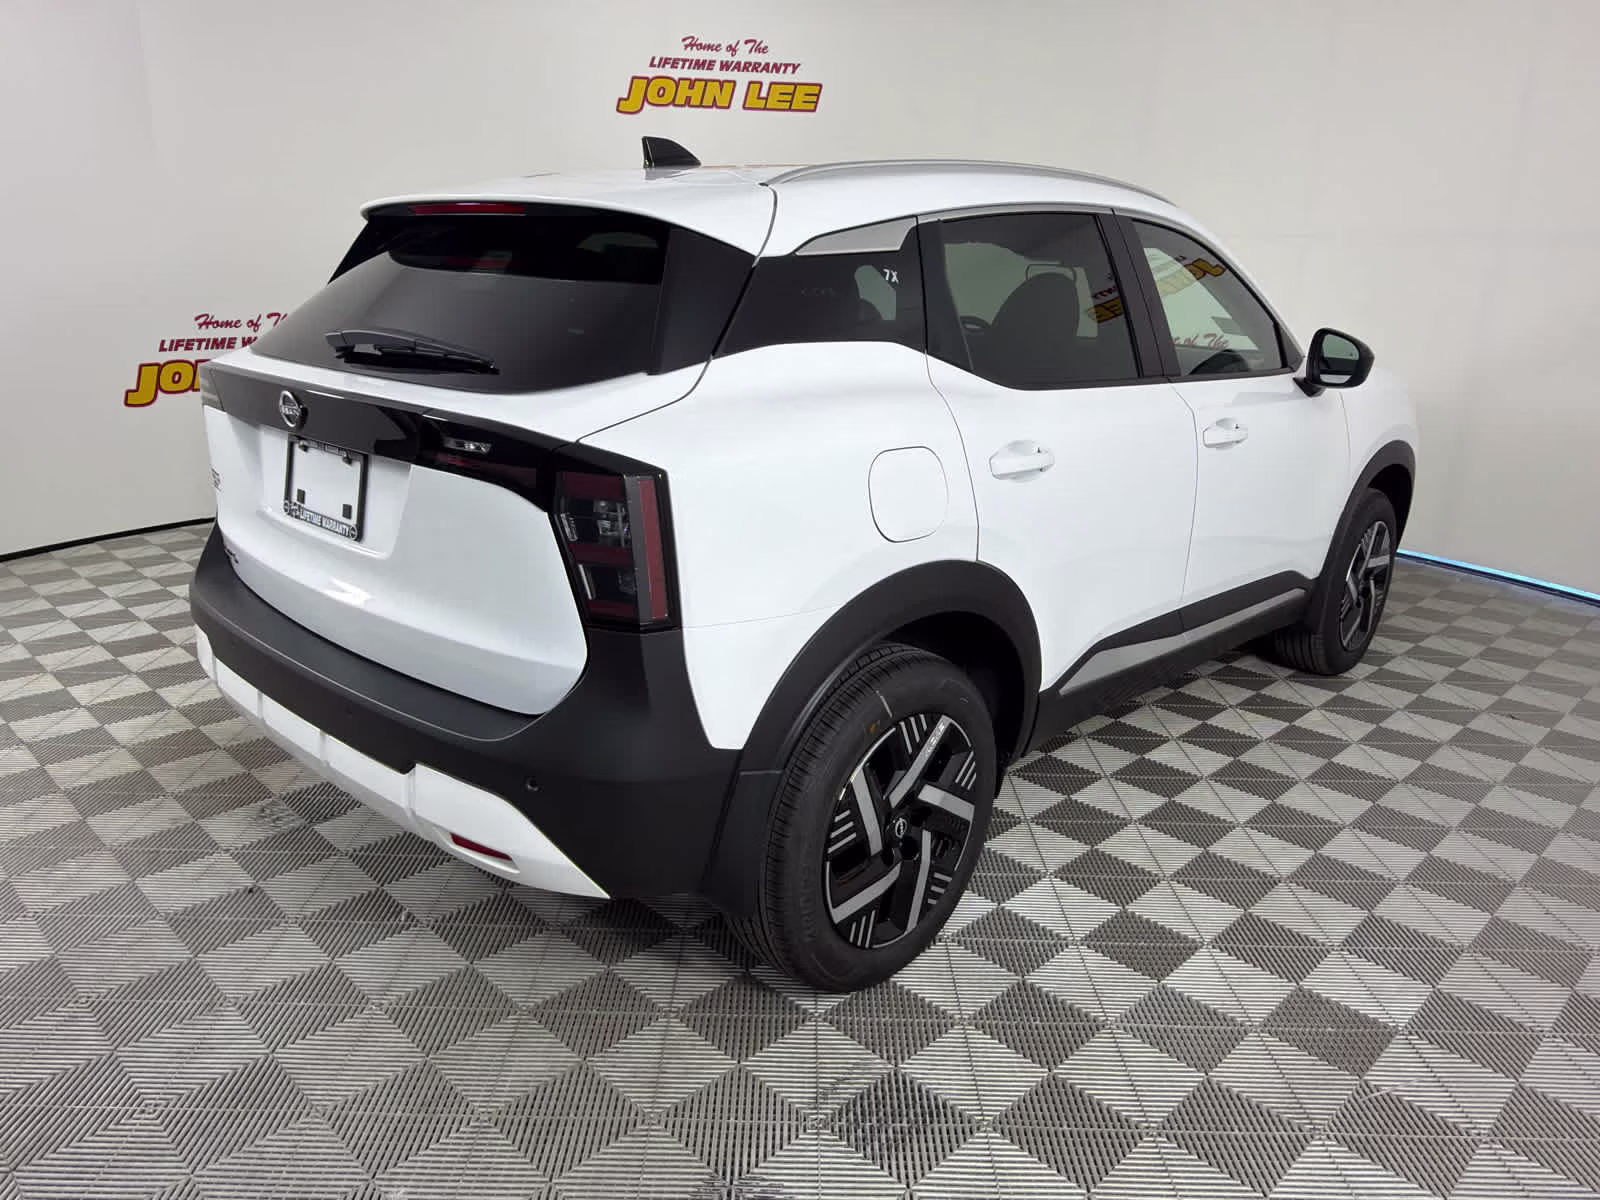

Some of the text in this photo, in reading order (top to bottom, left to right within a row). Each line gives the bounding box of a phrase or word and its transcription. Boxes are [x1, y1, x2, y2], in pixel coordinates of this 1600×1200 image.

[682, 35, 769, 56] Home of The
[649, 56, 801, 75] LIFETIME WARRANTY
[616, 75, 823, 114] JOHN LEE
[194, 313, 242, 330] Home
[246, 314, 262, 332] of
[159, 337, 237, 352] LIFETIME
[124, 359, 212, 407] JO
